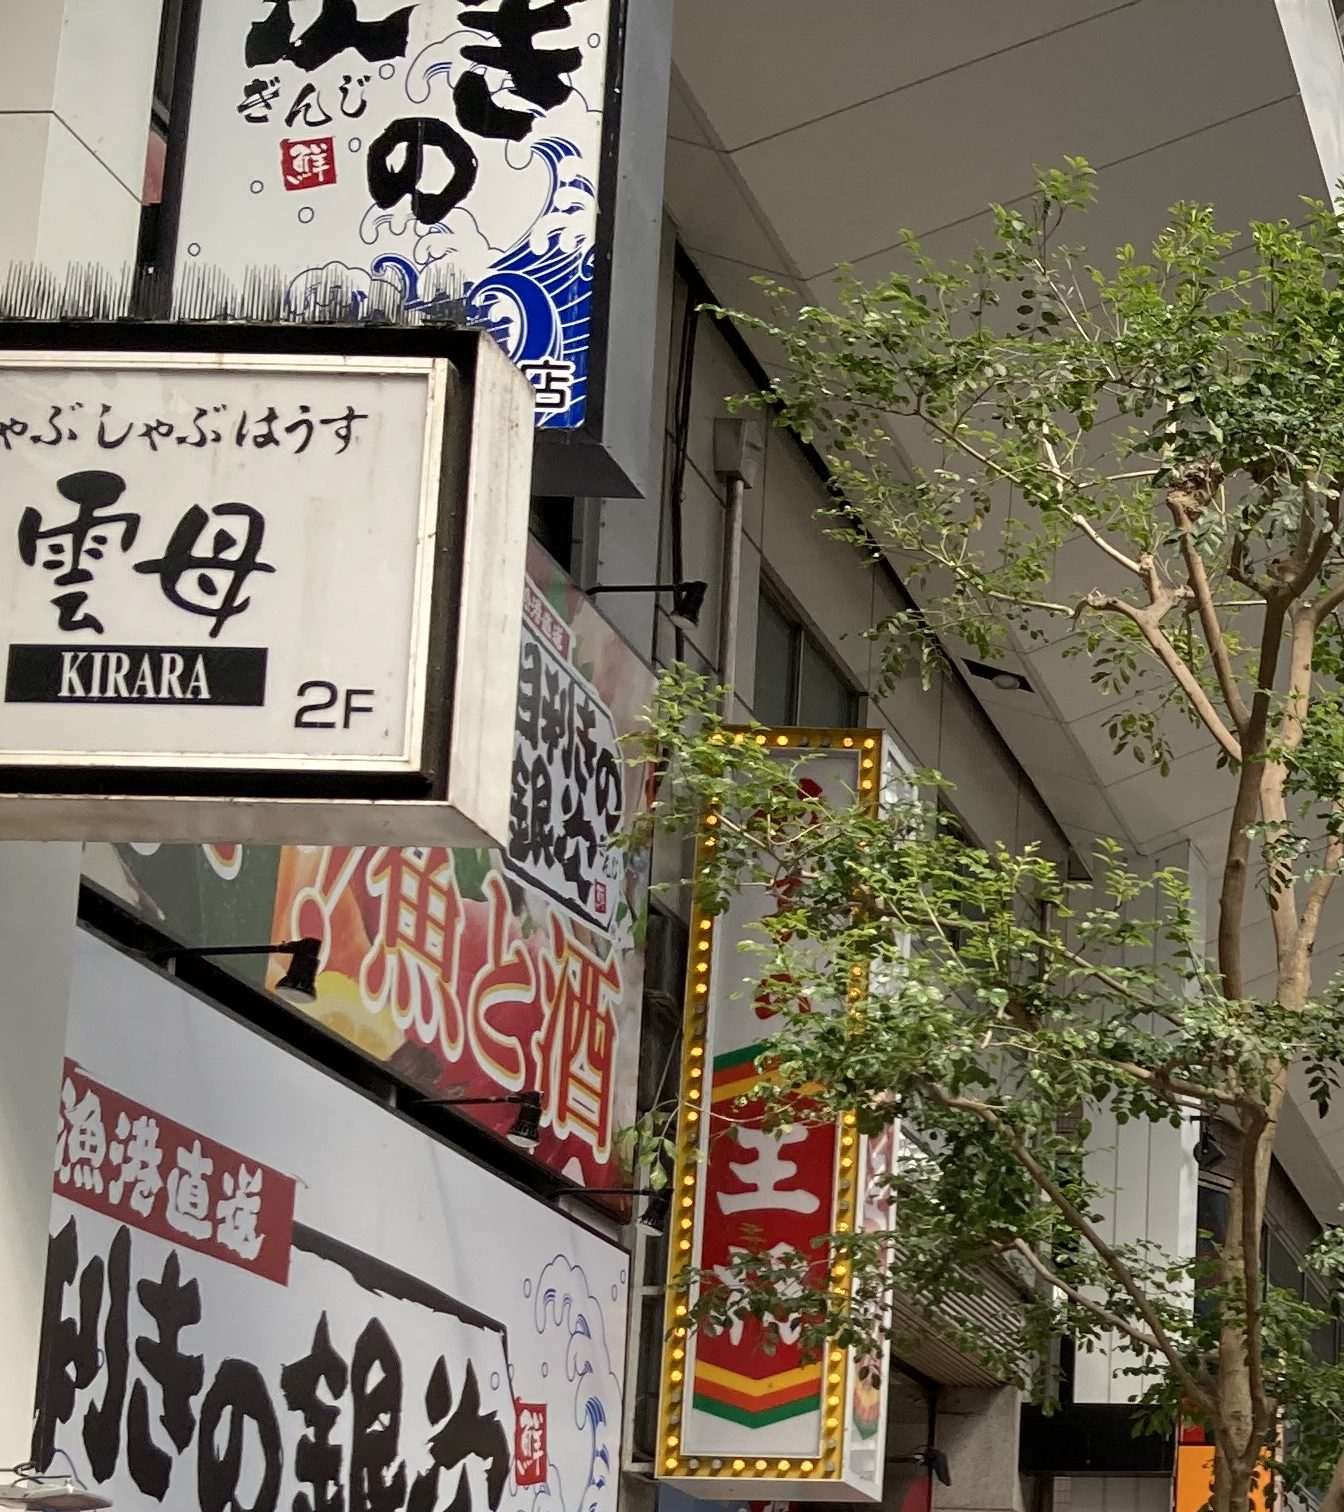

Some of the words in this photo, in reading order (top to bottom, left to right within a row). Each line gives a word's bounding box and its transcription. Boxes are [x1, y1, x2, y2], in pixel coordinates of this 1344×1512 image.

[237, 74, 372, 128] ぎんじ
[17, 469, 276, 640] 雲母
[58, 652, 213, 701] KIRARA
[294, 681, 376, 731] 2F
[52, 1070, 266, 1264] 漁港直送
